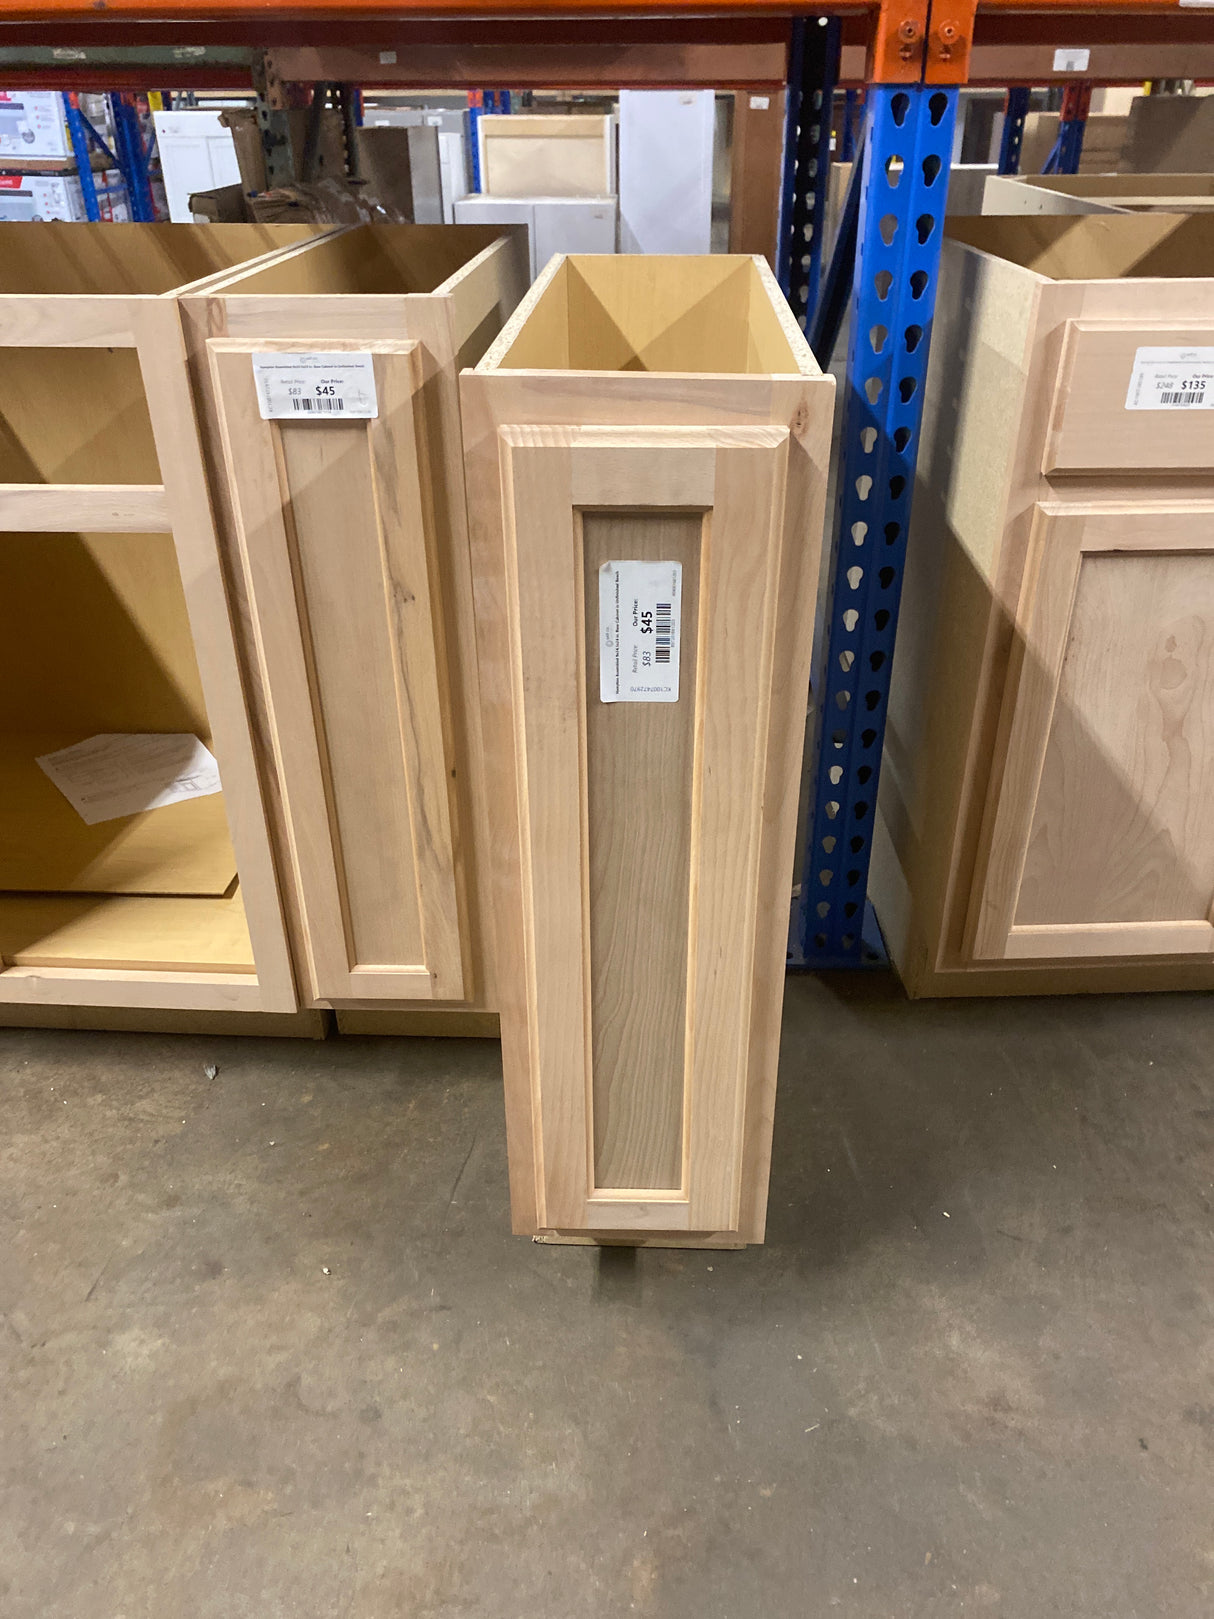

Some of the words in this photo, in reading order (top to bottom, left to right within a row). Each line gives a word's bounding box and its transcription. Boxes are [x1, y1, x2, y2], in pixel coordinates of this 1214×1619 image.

[1181, 380, 1207, 390] $135
[288, 387, 302, 396] $83
[315, 386, 336, 396] $45
[640, 611, 653, 634] $45
[642, 650, 651, 667] $83
